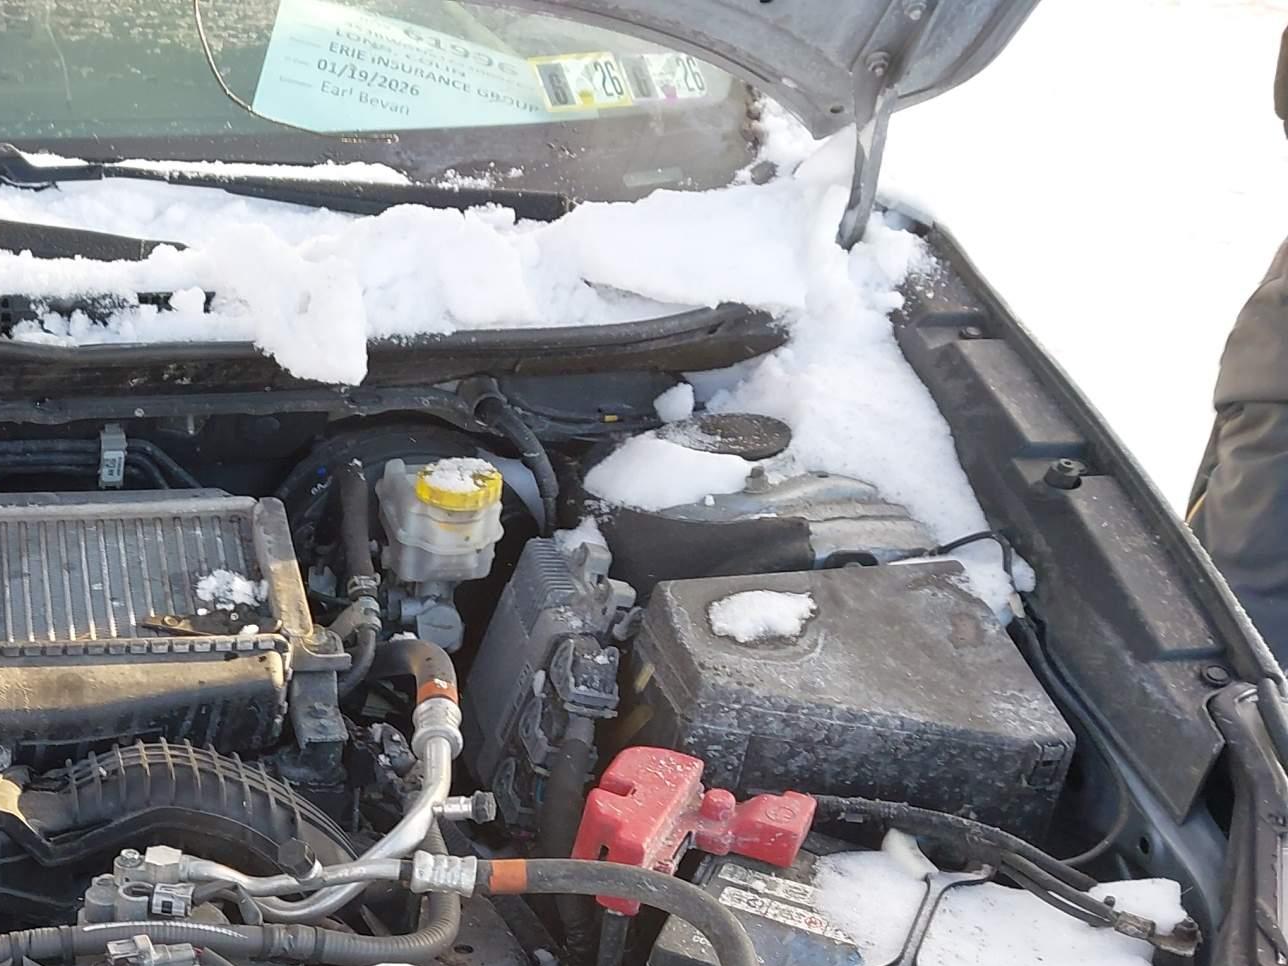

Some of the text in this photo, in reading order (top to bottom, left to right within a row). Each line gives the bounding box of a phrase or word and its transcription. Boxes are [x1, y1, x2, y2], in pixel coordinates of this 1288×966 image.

[316, 58, 421, 98] 01/19/2026
[328, 41, 367, 63] ERIE
[371, 56, 470, 94] INSURANCE
[594, 60, 624, 97] 26
[675, 56, 705, 92] 26
